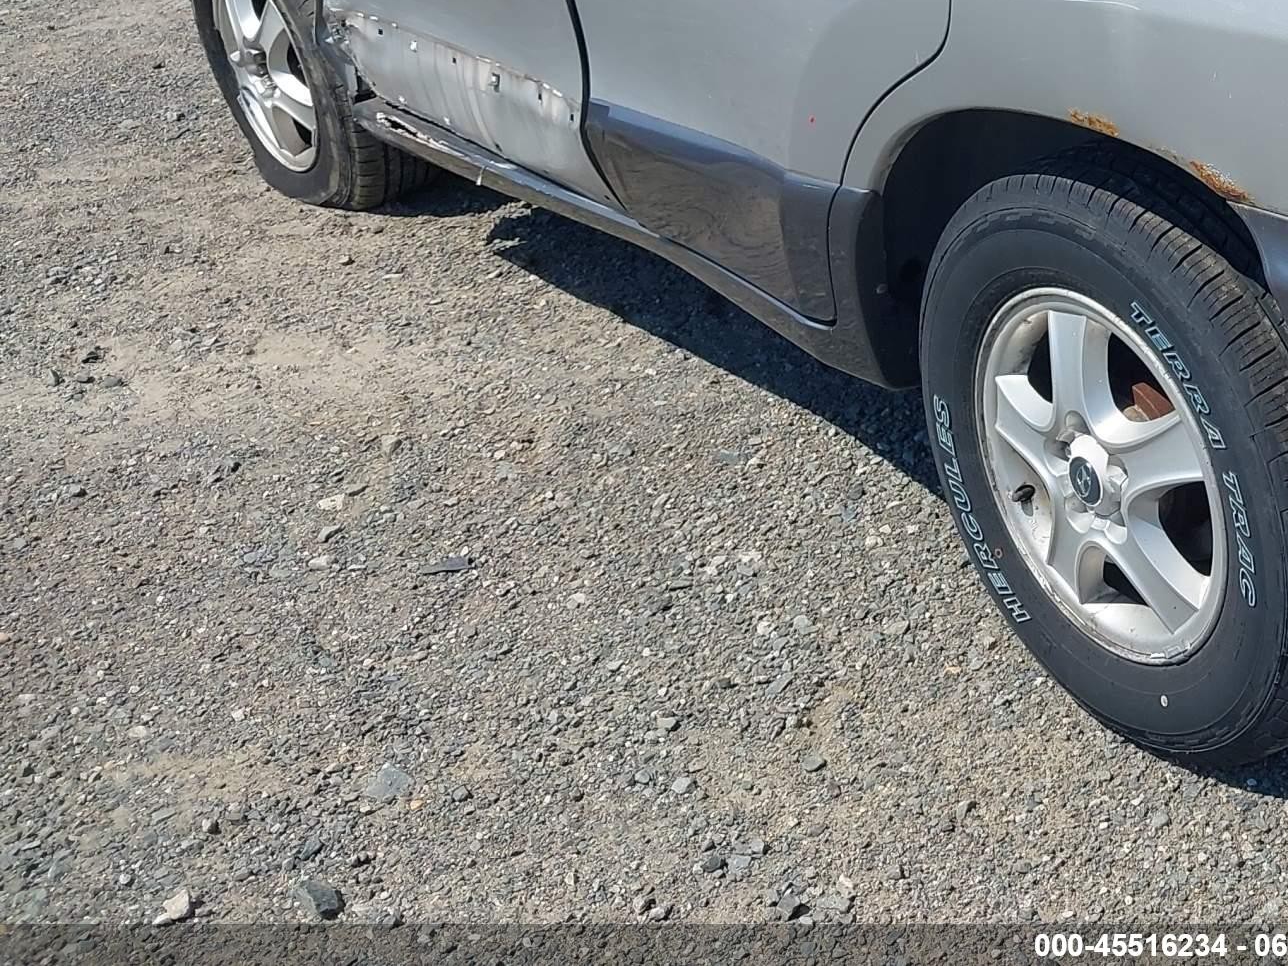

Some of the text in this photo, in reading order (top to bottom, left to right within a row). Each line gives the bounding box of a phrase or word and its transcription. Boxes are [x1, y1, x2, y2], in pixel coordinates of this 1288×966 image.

[933, 395, 1031, 624] HERCULES
[1130, 301, 1257, 608] TERRA TRAC
